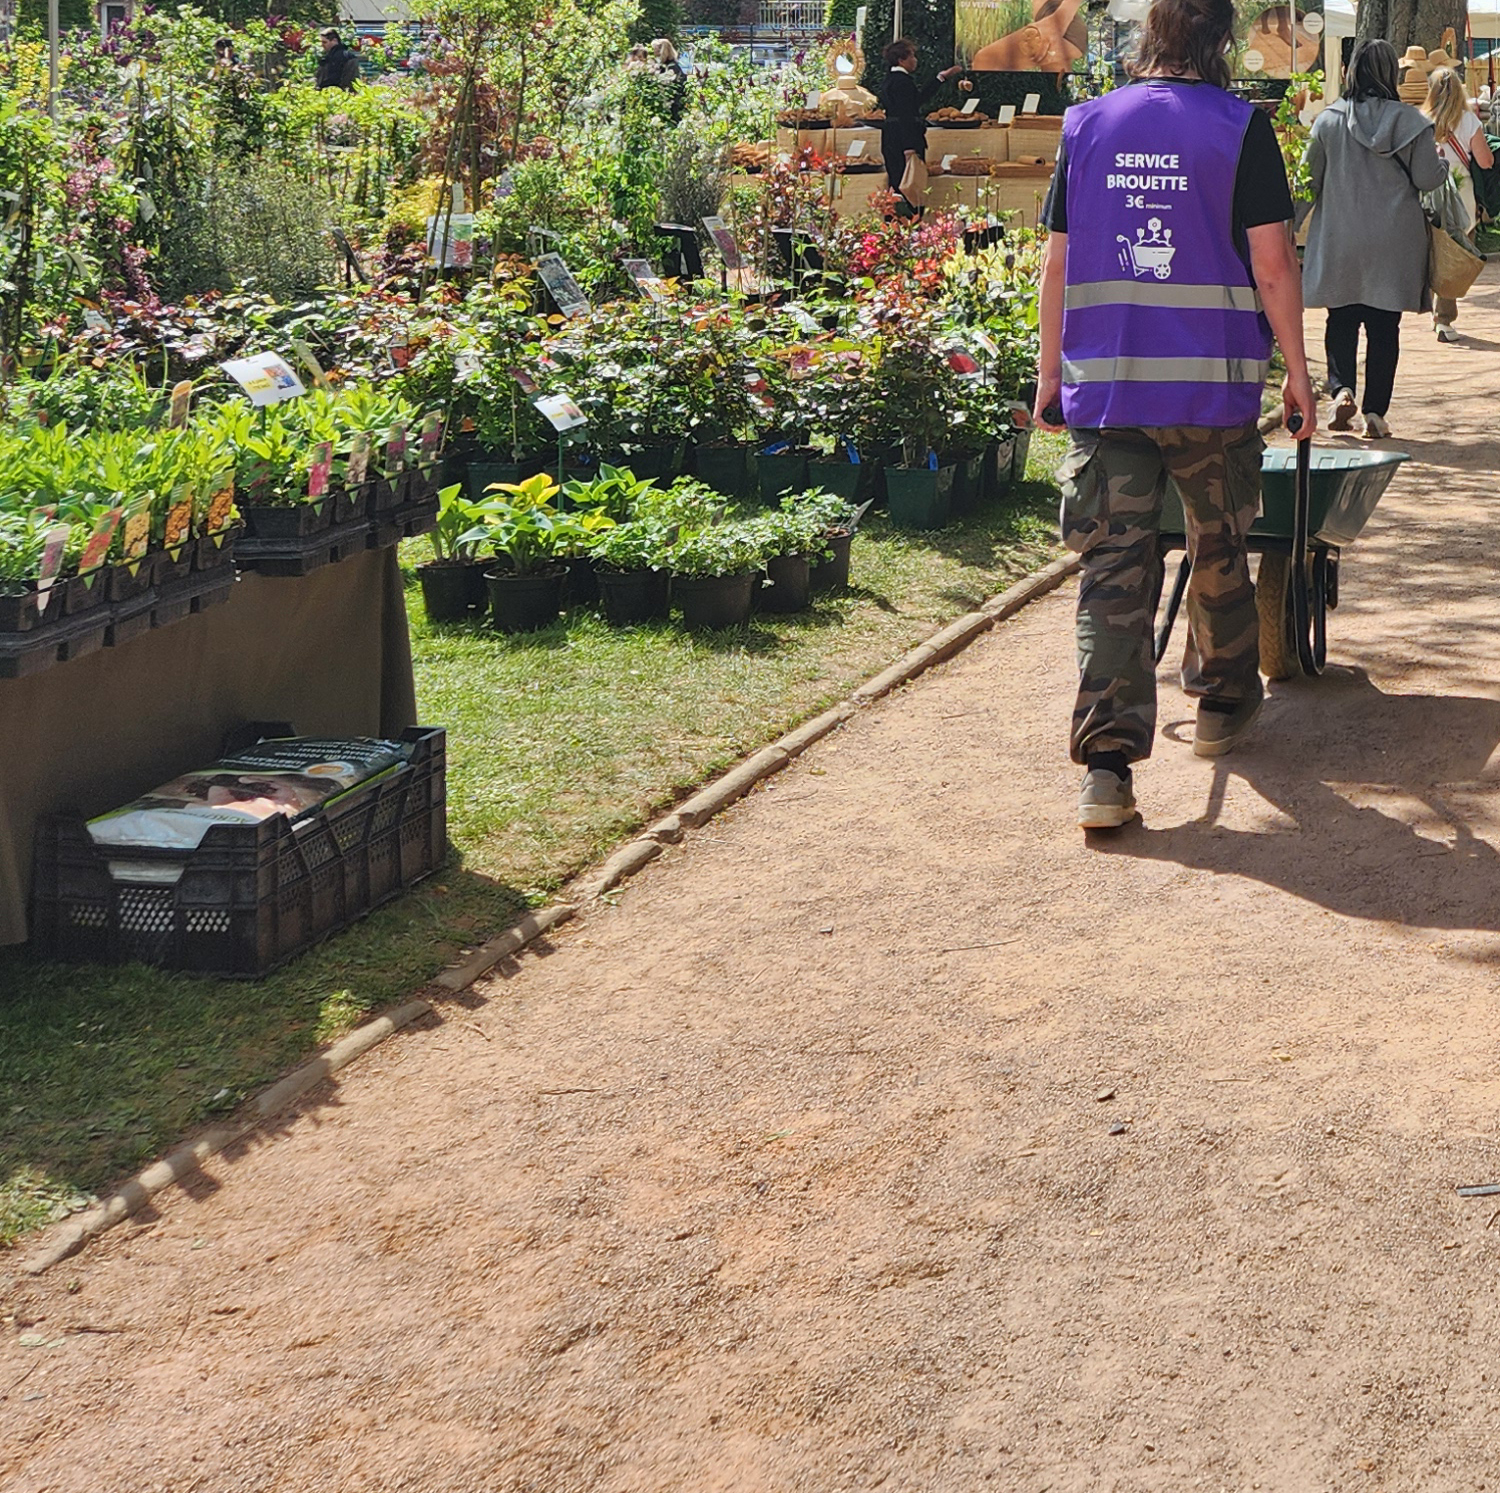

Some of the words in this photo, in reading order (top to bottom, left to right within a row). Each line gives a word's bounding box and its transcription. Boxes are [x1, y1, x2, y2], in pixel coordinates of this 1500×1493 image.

[1115, 153, 1179, 169] SERVICE
[1106, 174, 1188, 191] BROUETTE
[1125, 194, 1145, 209] 3€
